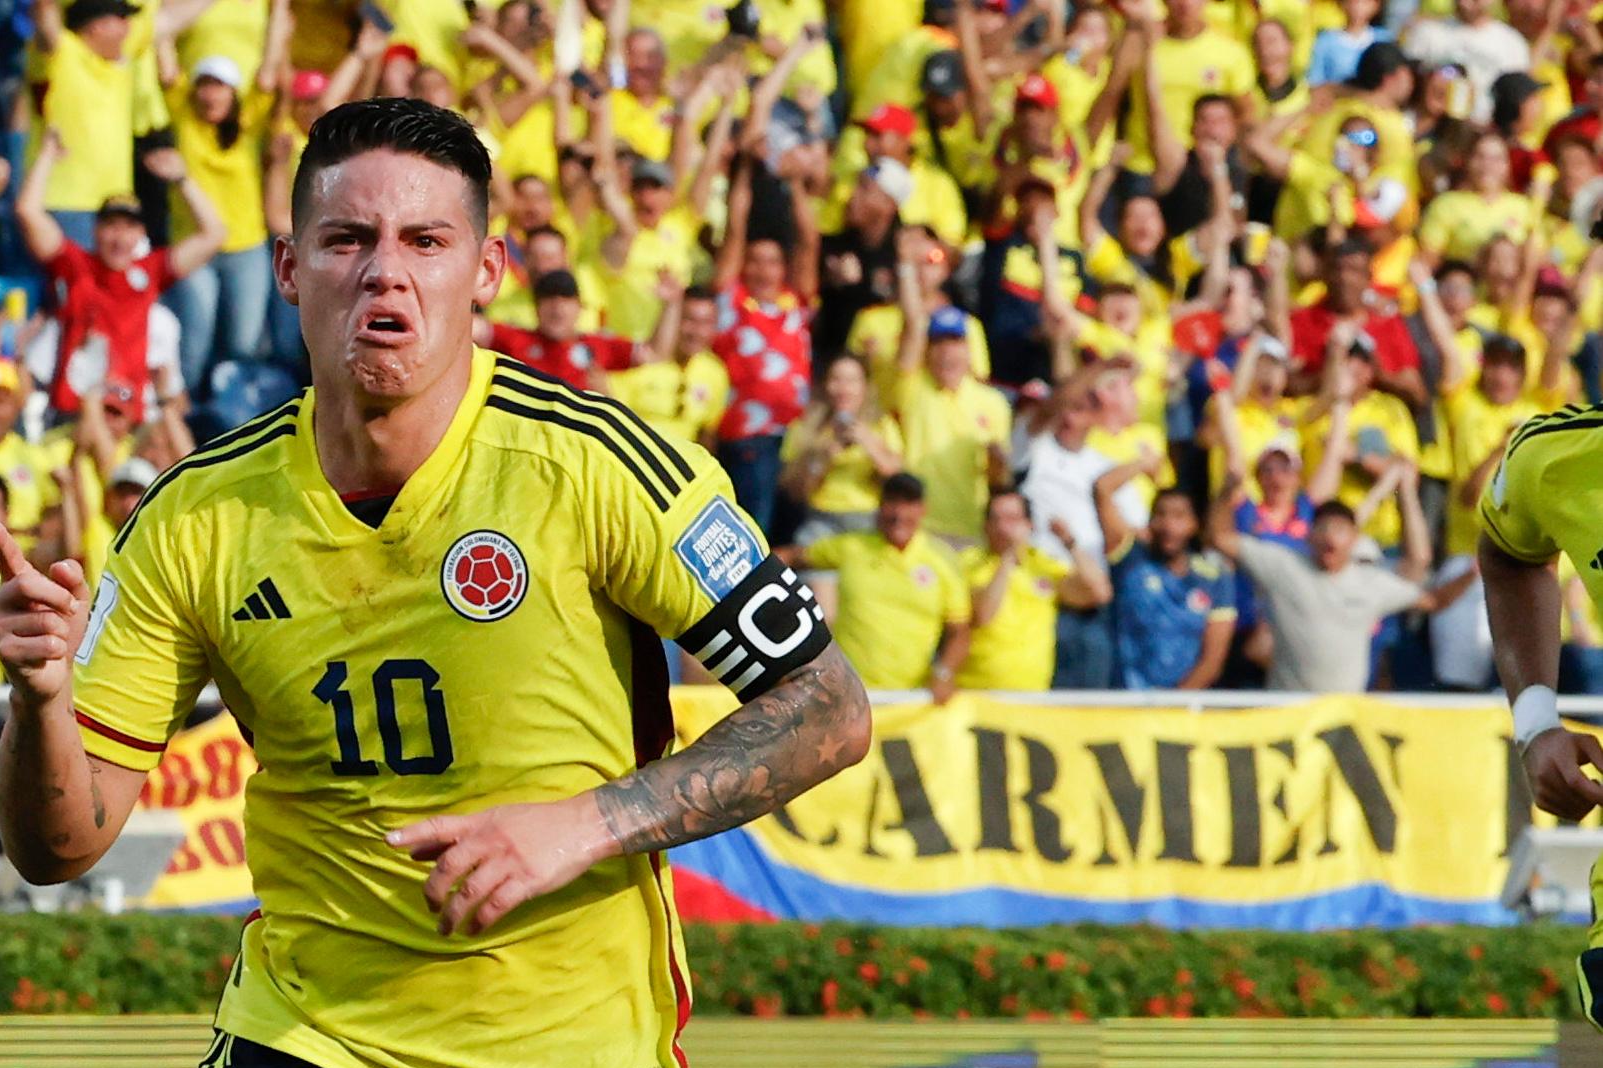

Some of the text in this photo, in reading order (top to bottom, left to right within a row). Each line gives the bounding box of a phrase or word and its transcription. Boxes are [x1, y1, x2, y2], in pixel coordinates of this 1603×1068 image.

[692, 518, 727, 554] FOOTBALL
[700, 527, 738, 567] UNITES
[311, 659, 454, 776] 10
